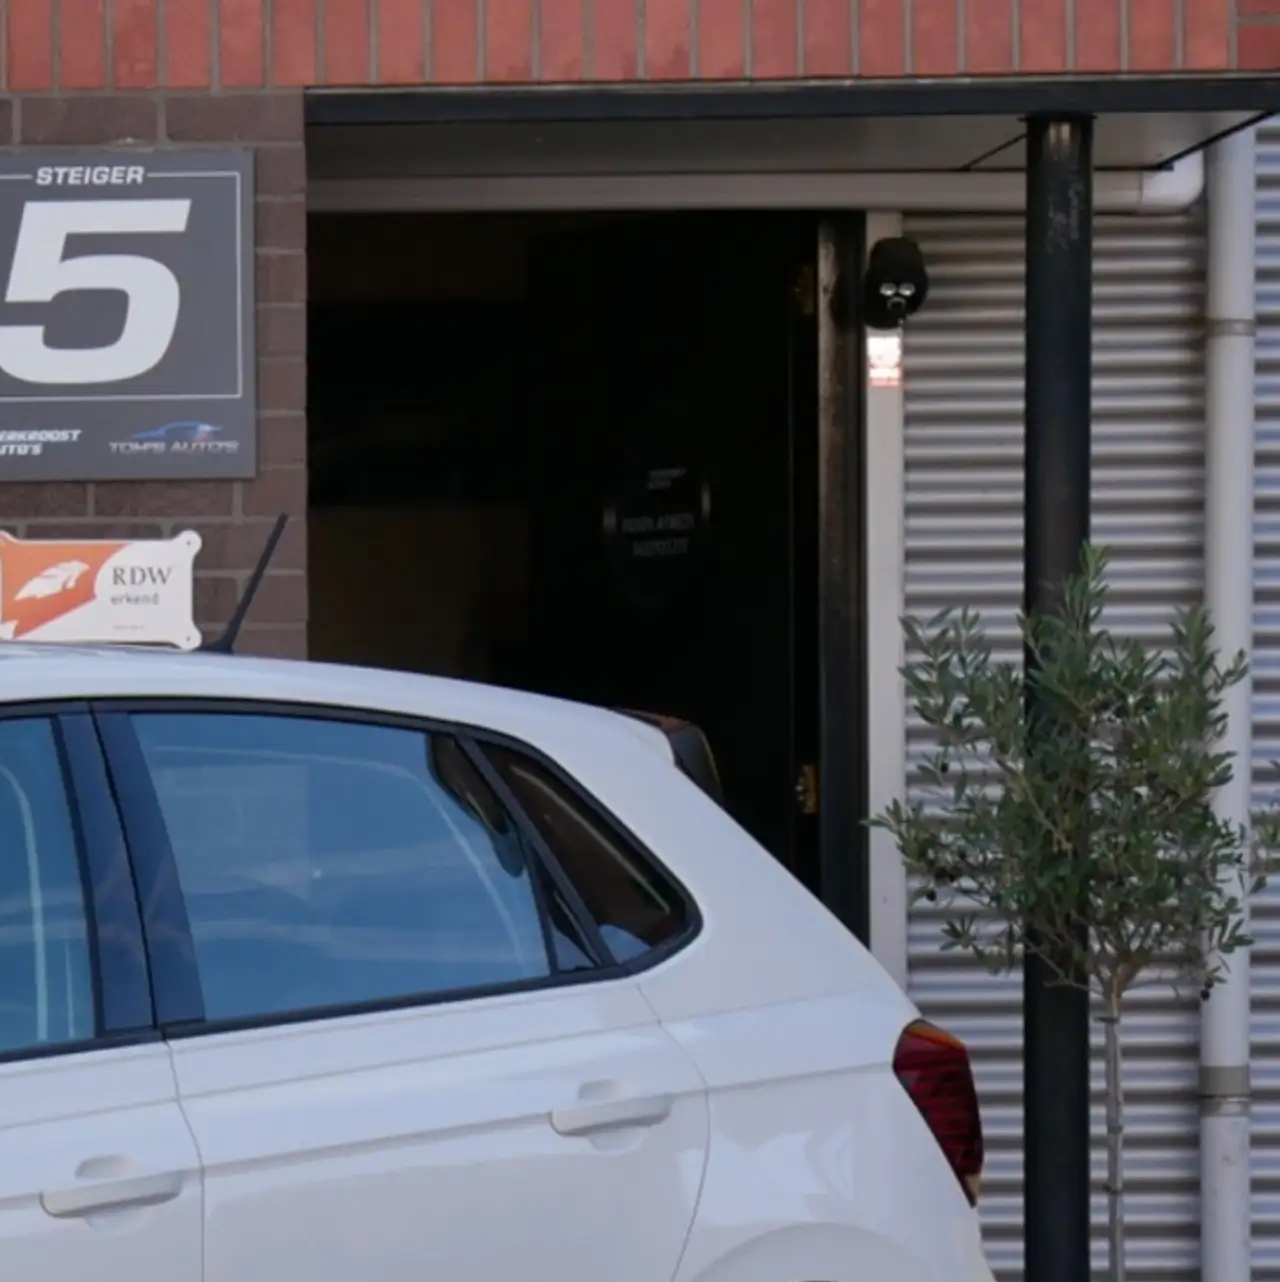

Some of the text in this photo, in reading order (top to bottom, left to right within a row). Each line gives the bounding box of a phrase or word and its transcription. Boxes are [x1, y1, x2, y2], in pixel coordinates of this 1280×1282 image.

[36, 166, 145, 186] STEIGER
[112, 566, 173, 586] RDW
[110, 592, 160, 605] erkend
